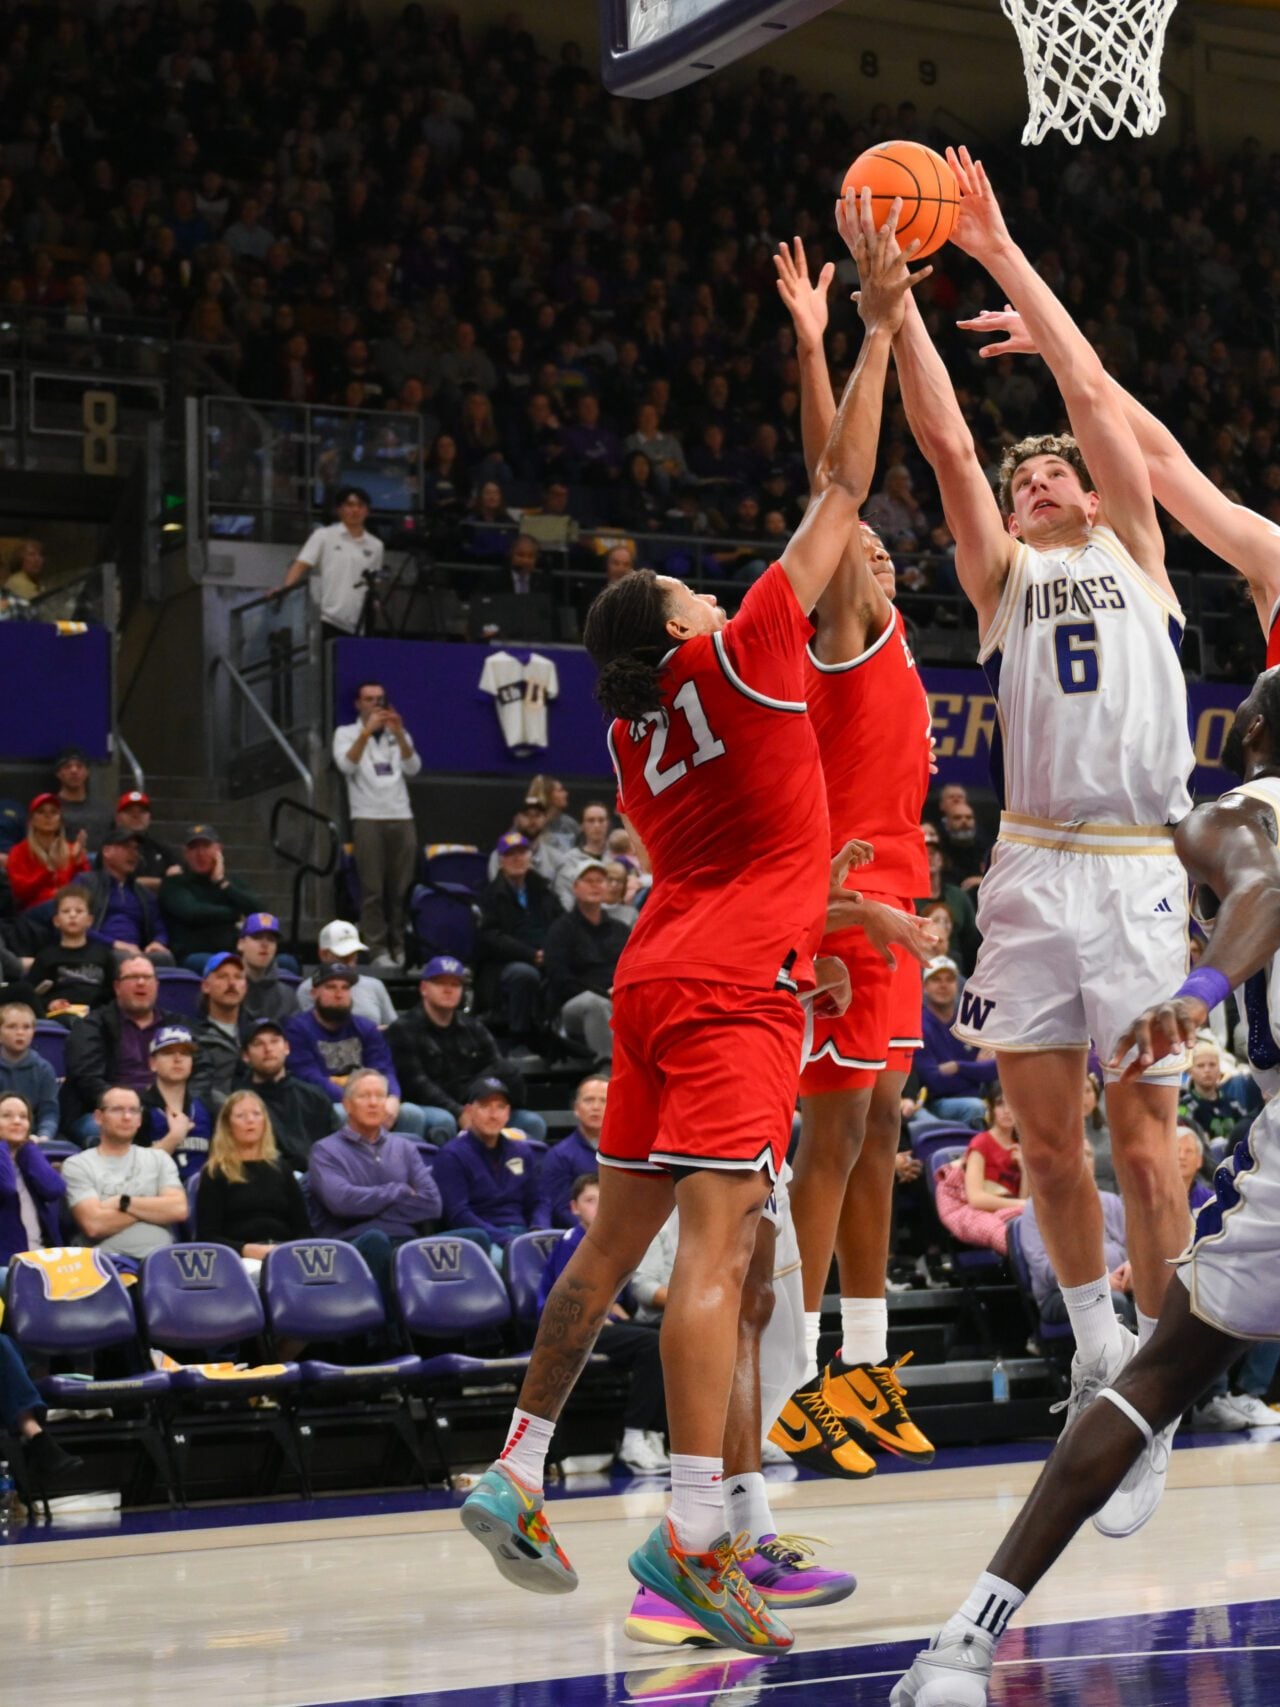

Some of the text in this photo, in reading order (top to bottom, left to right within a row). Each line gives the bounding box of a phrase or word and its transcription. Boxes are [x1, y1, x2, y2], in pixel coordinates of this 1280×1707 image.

[861, 50, 879, 78] 8
[919, 60, 937, 86] 9
[83, 389, 117, 476] 8
[1054, 620, 1102, 696] 6
[630, 680, 727, 797] 21
[440, 958, 460, 973] W
[959, 989, 996, 1032] W
[170, 1248, 218, 1281] W
[293, 1245, 338, 1277] W
[420, 1242, 462, 1273] W
